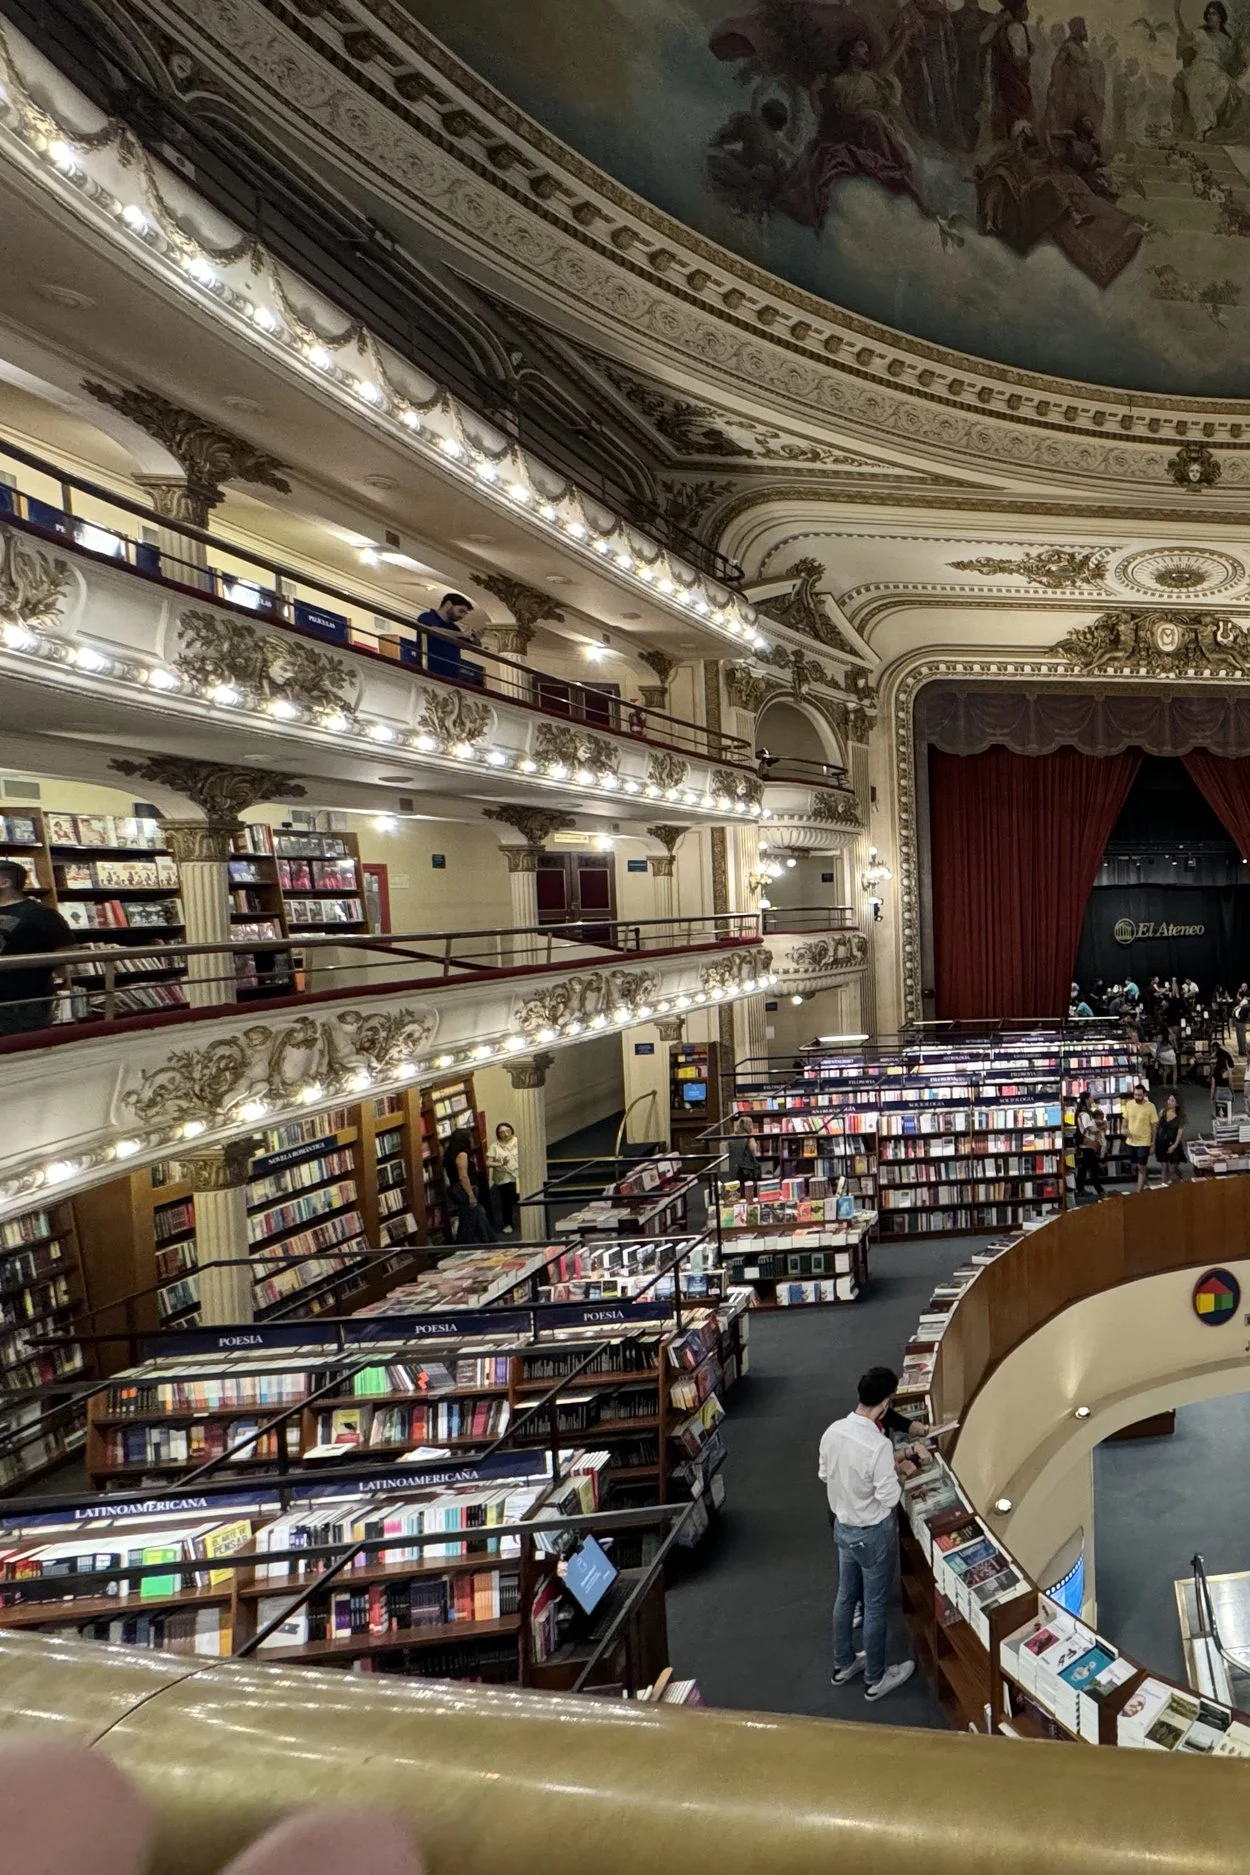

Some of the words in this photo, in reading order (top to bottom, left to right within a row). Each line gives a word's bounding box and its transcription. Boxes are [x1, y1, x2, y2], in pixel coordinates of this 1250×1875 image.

[1136, 922, 1155, 938] El
[1155, 922, 1205, 937] Ateneo
[268, 1153, 292, 1165] NOVELA
[583, 1309, 624, 1322] POESIA
[415, 1323, 459, 1335] POESIA
[218, 1334, 263, 1348] POESIA
[74, 1497, 208, 1519] LATINOAMERICANA
